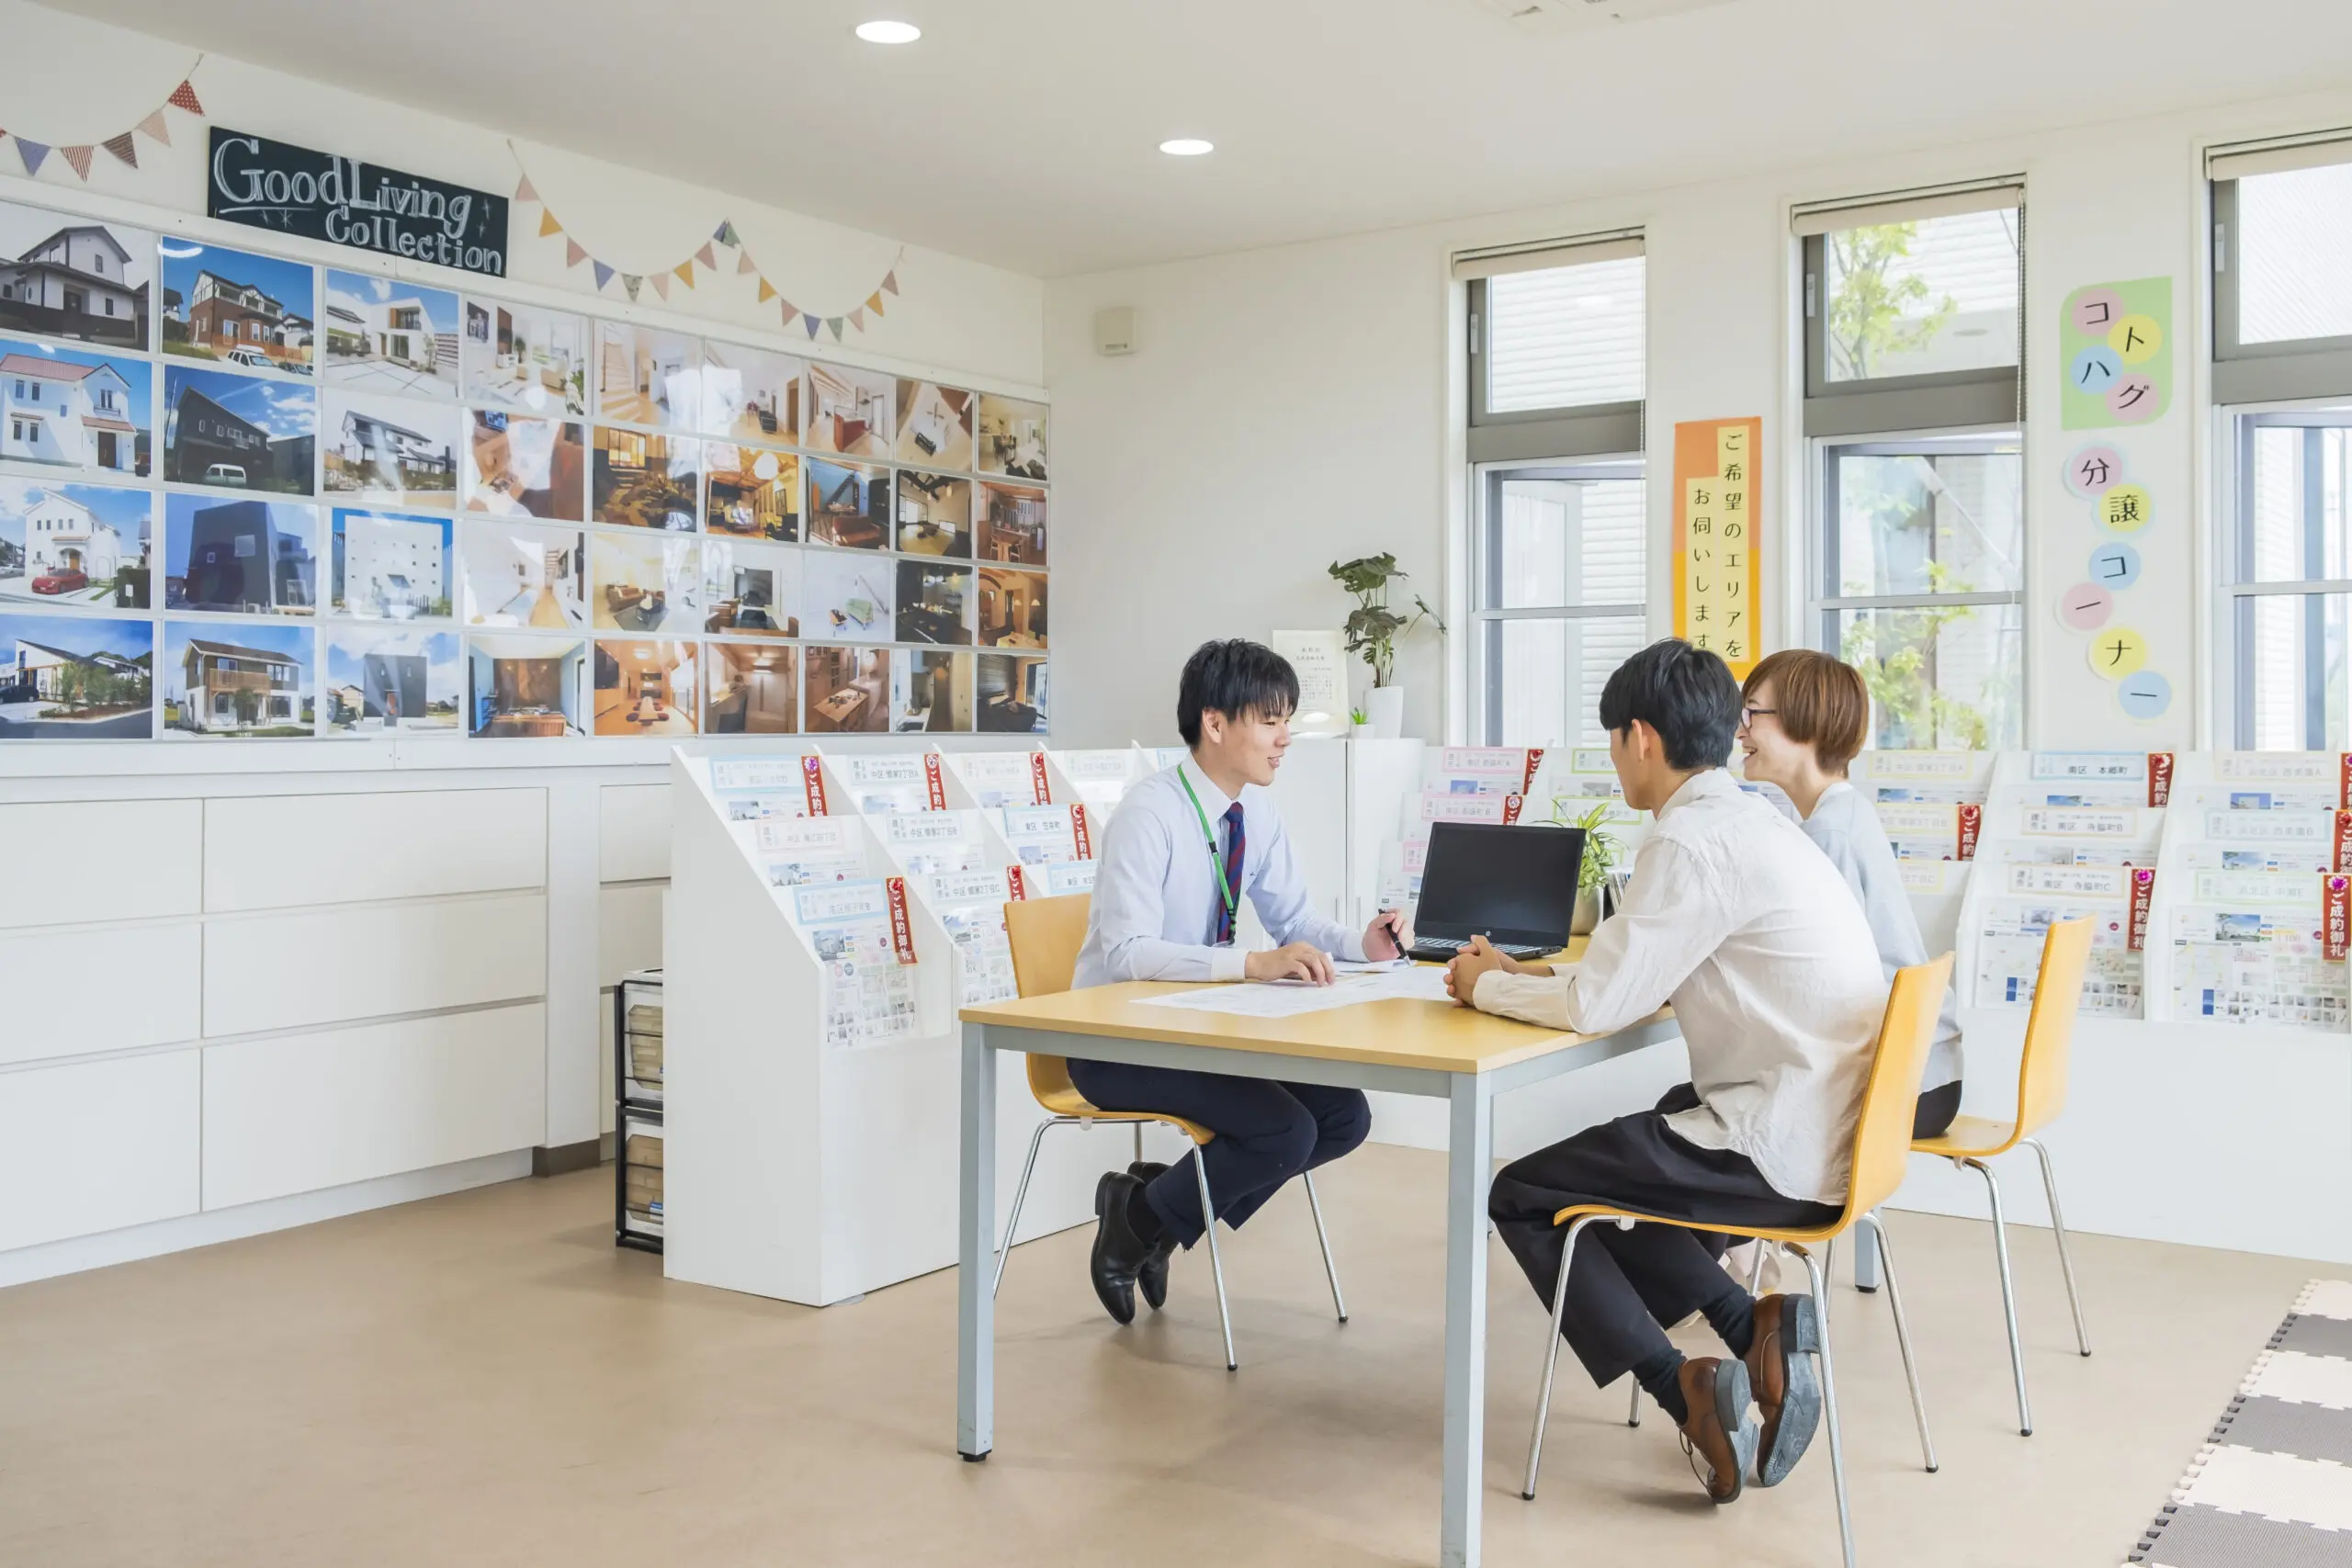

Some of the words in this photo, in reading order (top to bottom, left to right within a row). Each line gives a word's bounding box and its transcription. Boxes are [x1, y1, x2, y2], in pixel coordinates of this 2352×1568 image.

[213, 138, 344, 205] Good
[341, 159, 472, 239] Living
[325, 206, 503, 275] Collection
[1692, 488, 1712, 650] お伺いします
[1724, 433, 1743, 658] ご希望のエリアを
[930, 771, 941, 810] ご成約
[2068, 765, 2087, 774] 南区
[2154, 770, 2167, 808] ご成約
[1962, 820, 1976, 861] ご成約
[893, 895, 911, 961] ご成約御礼
[2133, 885, 2150, 948] ご成約御礼
[2330, 892, 2345, 957] ご成約御礼
